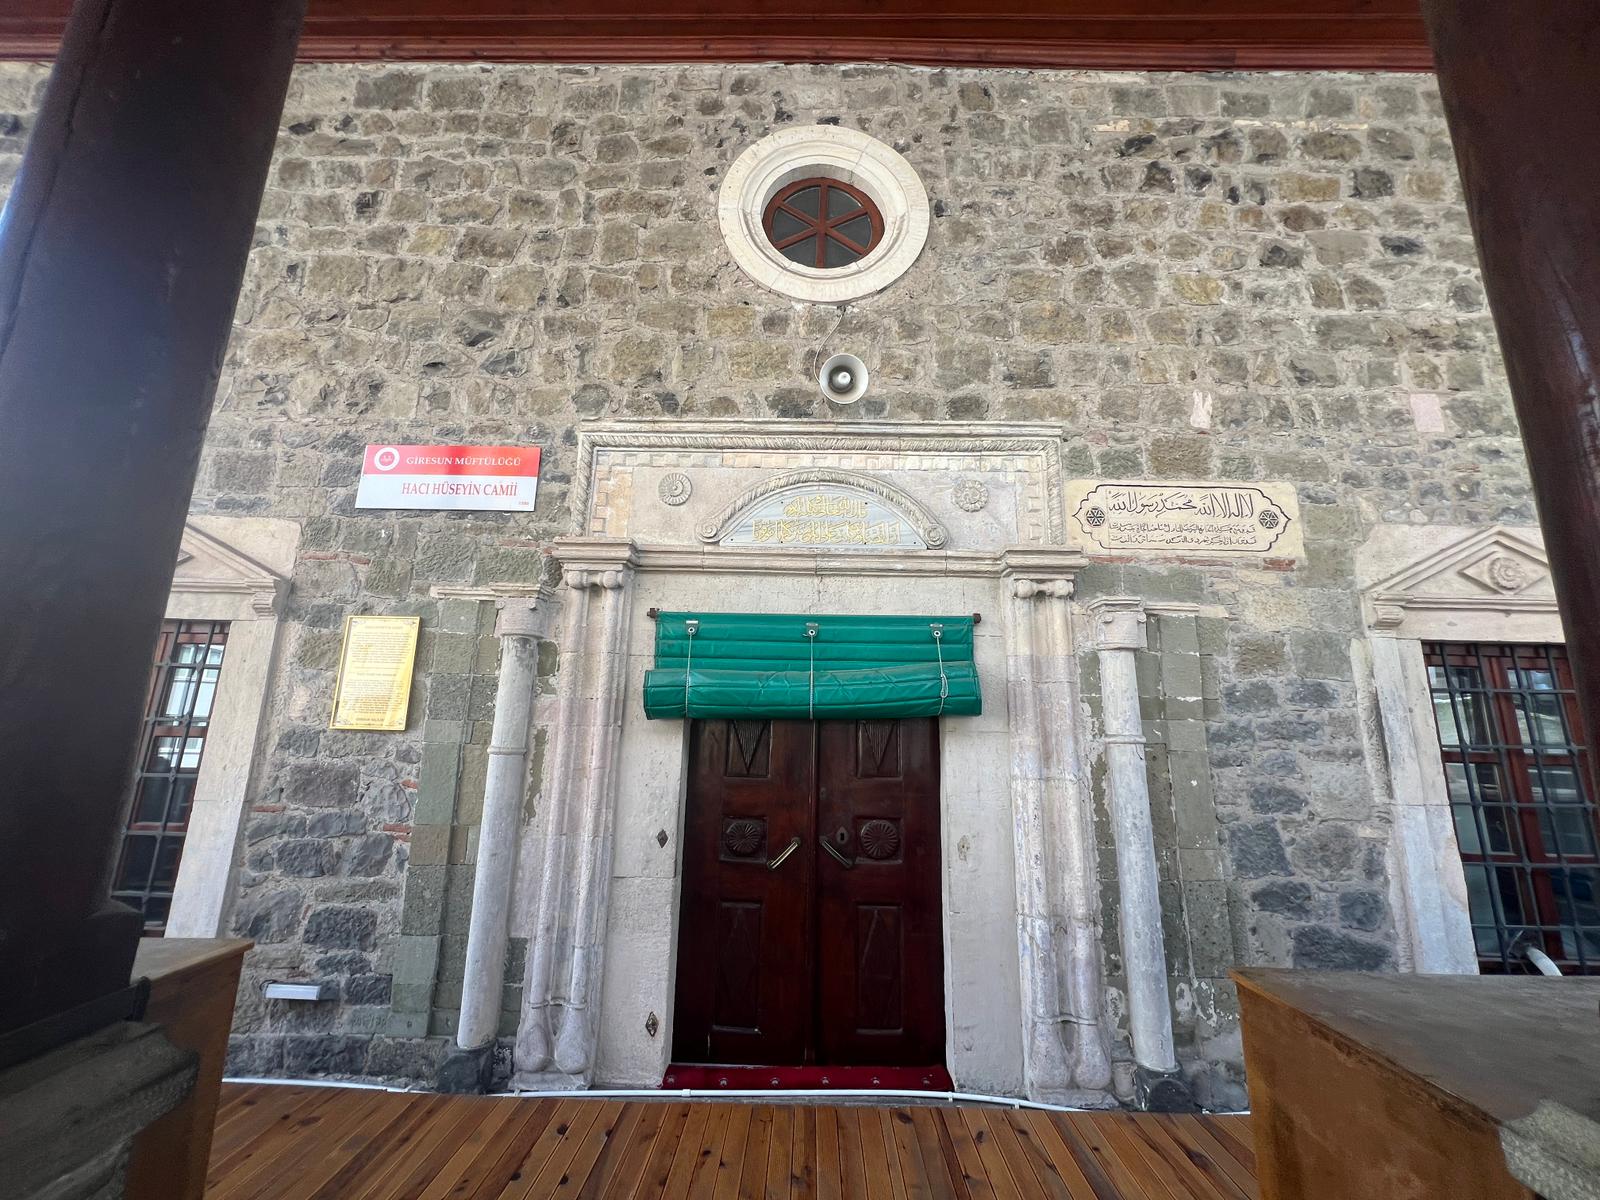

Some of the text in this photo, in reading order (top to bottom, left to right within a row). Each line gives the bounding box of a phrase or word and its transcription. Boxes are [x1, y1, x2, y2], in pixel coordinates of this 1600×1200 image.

[406, 455, 521, 467] GİRESUN MÜFTÜLÜĞÜ
[401, 481, 518, 497] HACI HÜSEYİN CAMİİ
